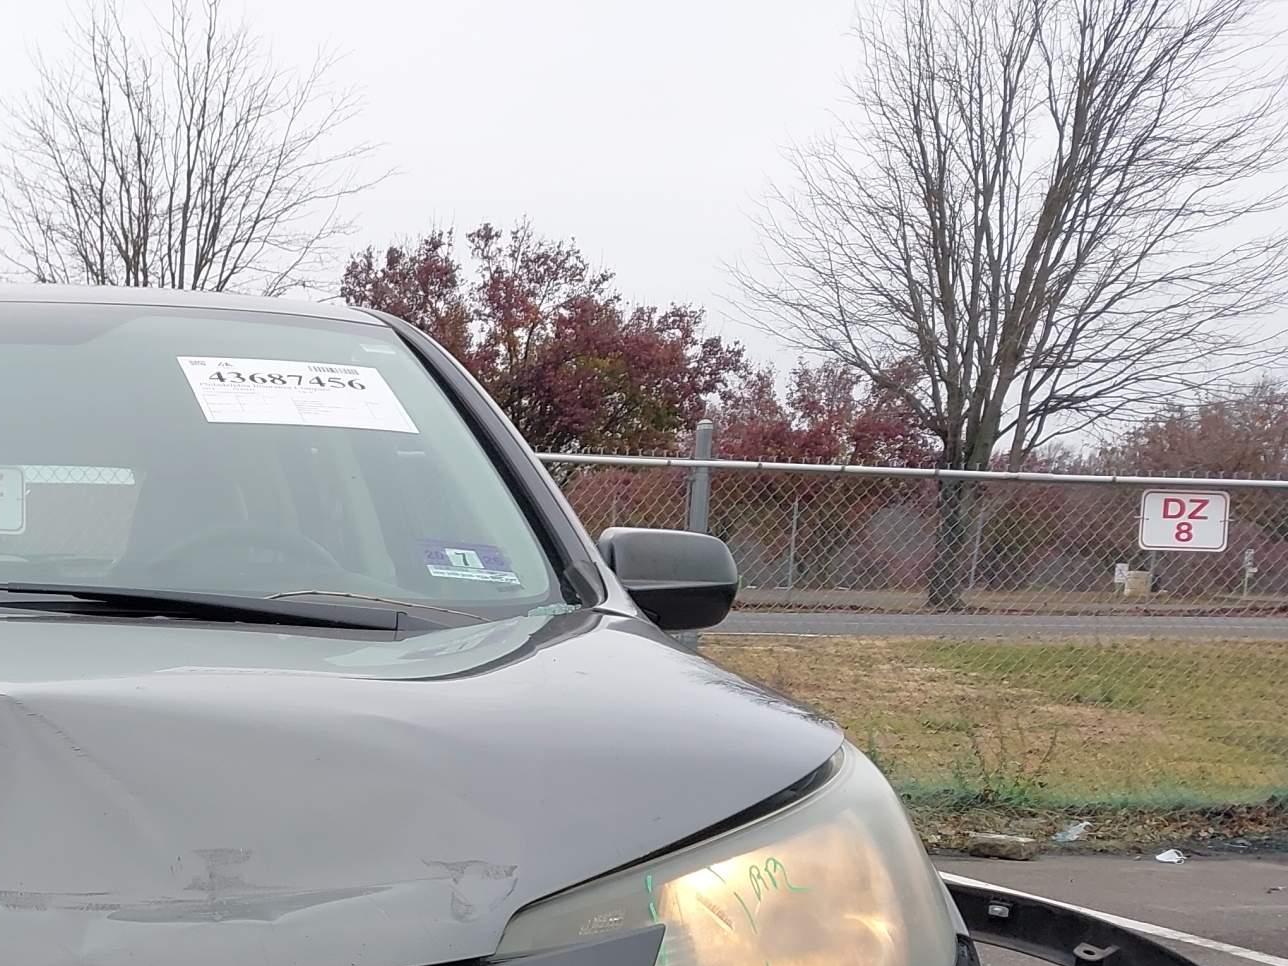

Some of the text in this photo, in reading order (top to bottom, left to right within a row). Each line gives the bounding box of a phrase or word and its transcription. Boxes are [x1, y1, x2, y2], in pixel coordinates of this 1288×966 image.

[208, 371, 366, 391] 43687456
[1162, 497, 1210, 520] DZ
[1174, 521, 1193, 542] 8
